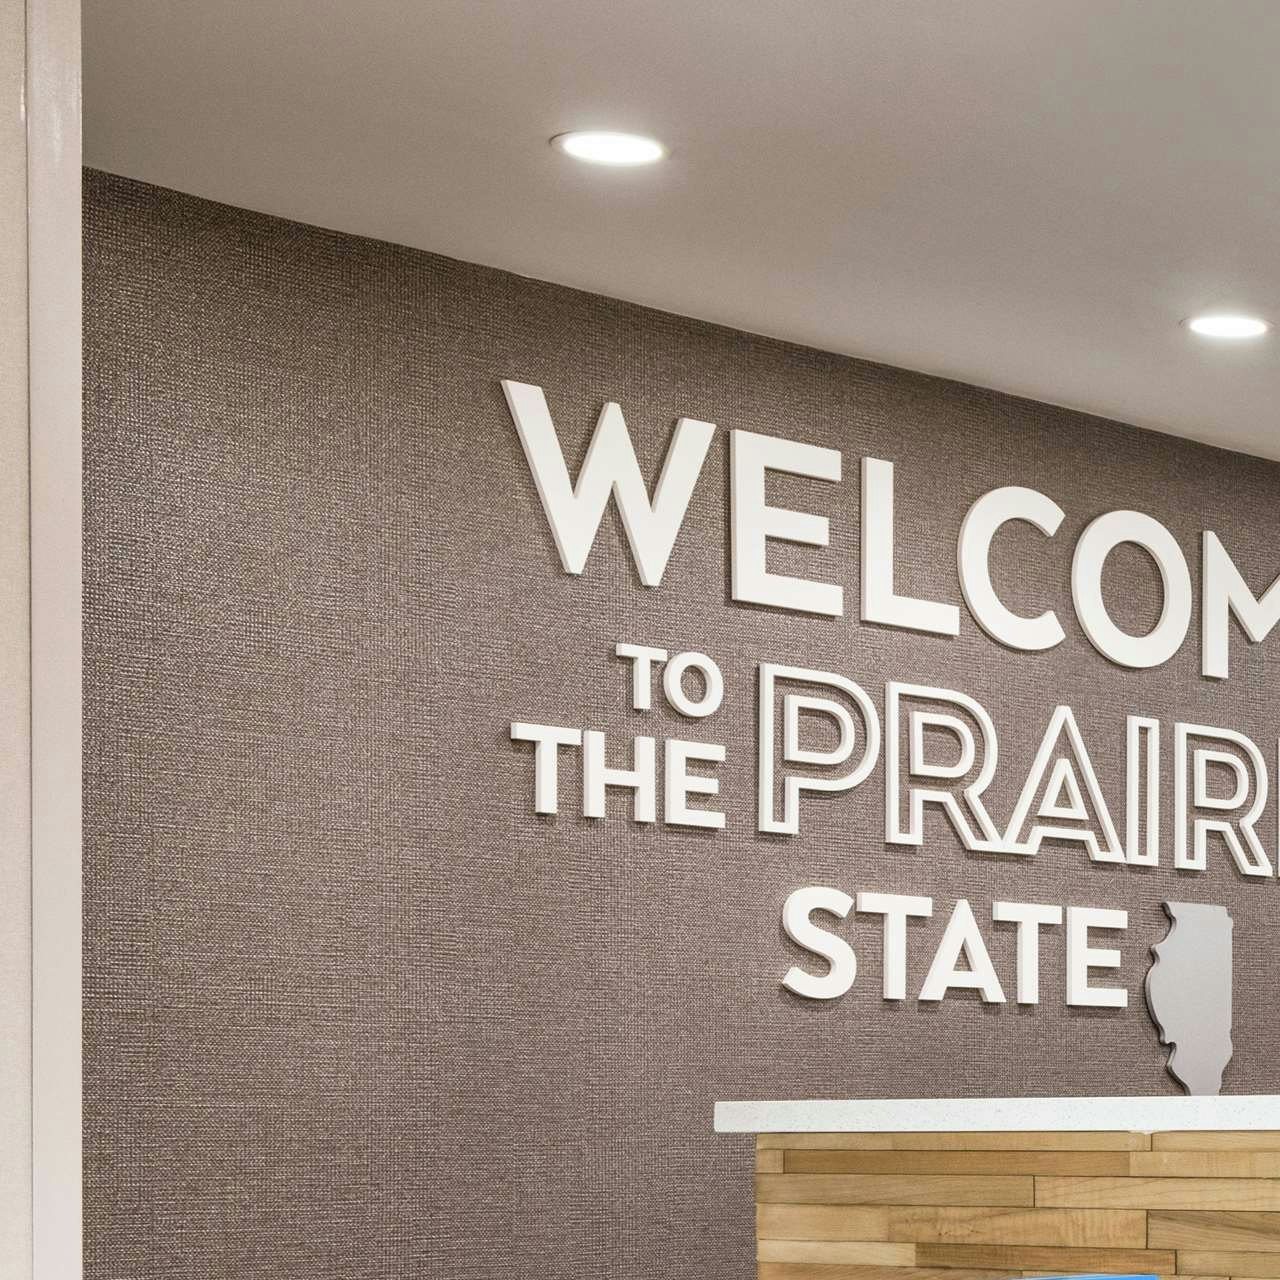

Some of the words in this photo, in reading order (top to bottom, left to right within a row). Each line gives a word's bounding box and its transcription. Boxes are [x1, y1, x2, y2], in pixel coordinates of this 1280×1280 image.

[615, 643, 725, 718] TO
[510, 722, 726, 830] THE
[781, 886, 1128, 1008] STATE
